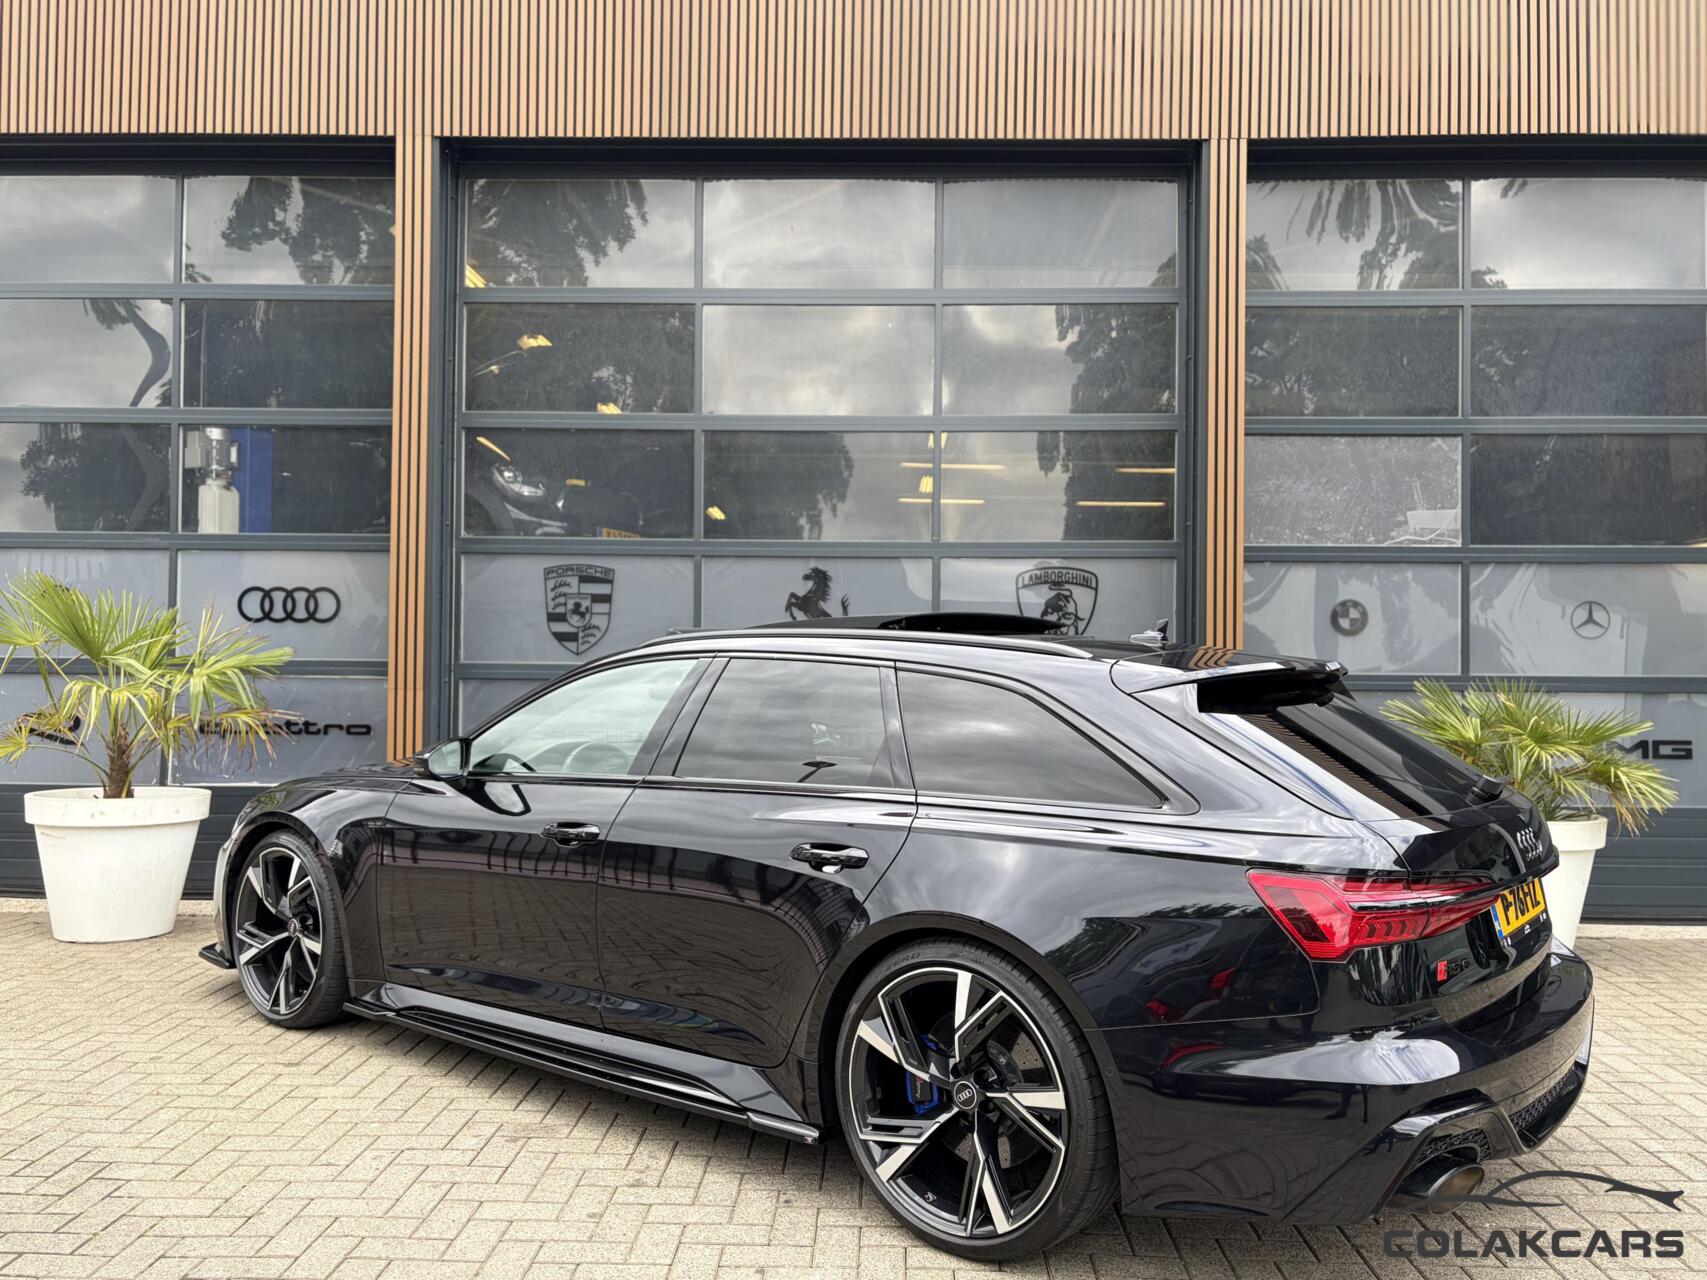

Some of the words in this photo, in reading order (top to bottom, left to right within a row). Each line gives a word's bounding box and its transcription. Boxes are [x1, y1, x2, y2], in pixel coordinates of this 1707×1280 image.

[546, 566, 612, 578] PORSCHE
[1021, 571, 1093, 588] LAMBORGHINI
[1605, 740, 1692, 760] MG
